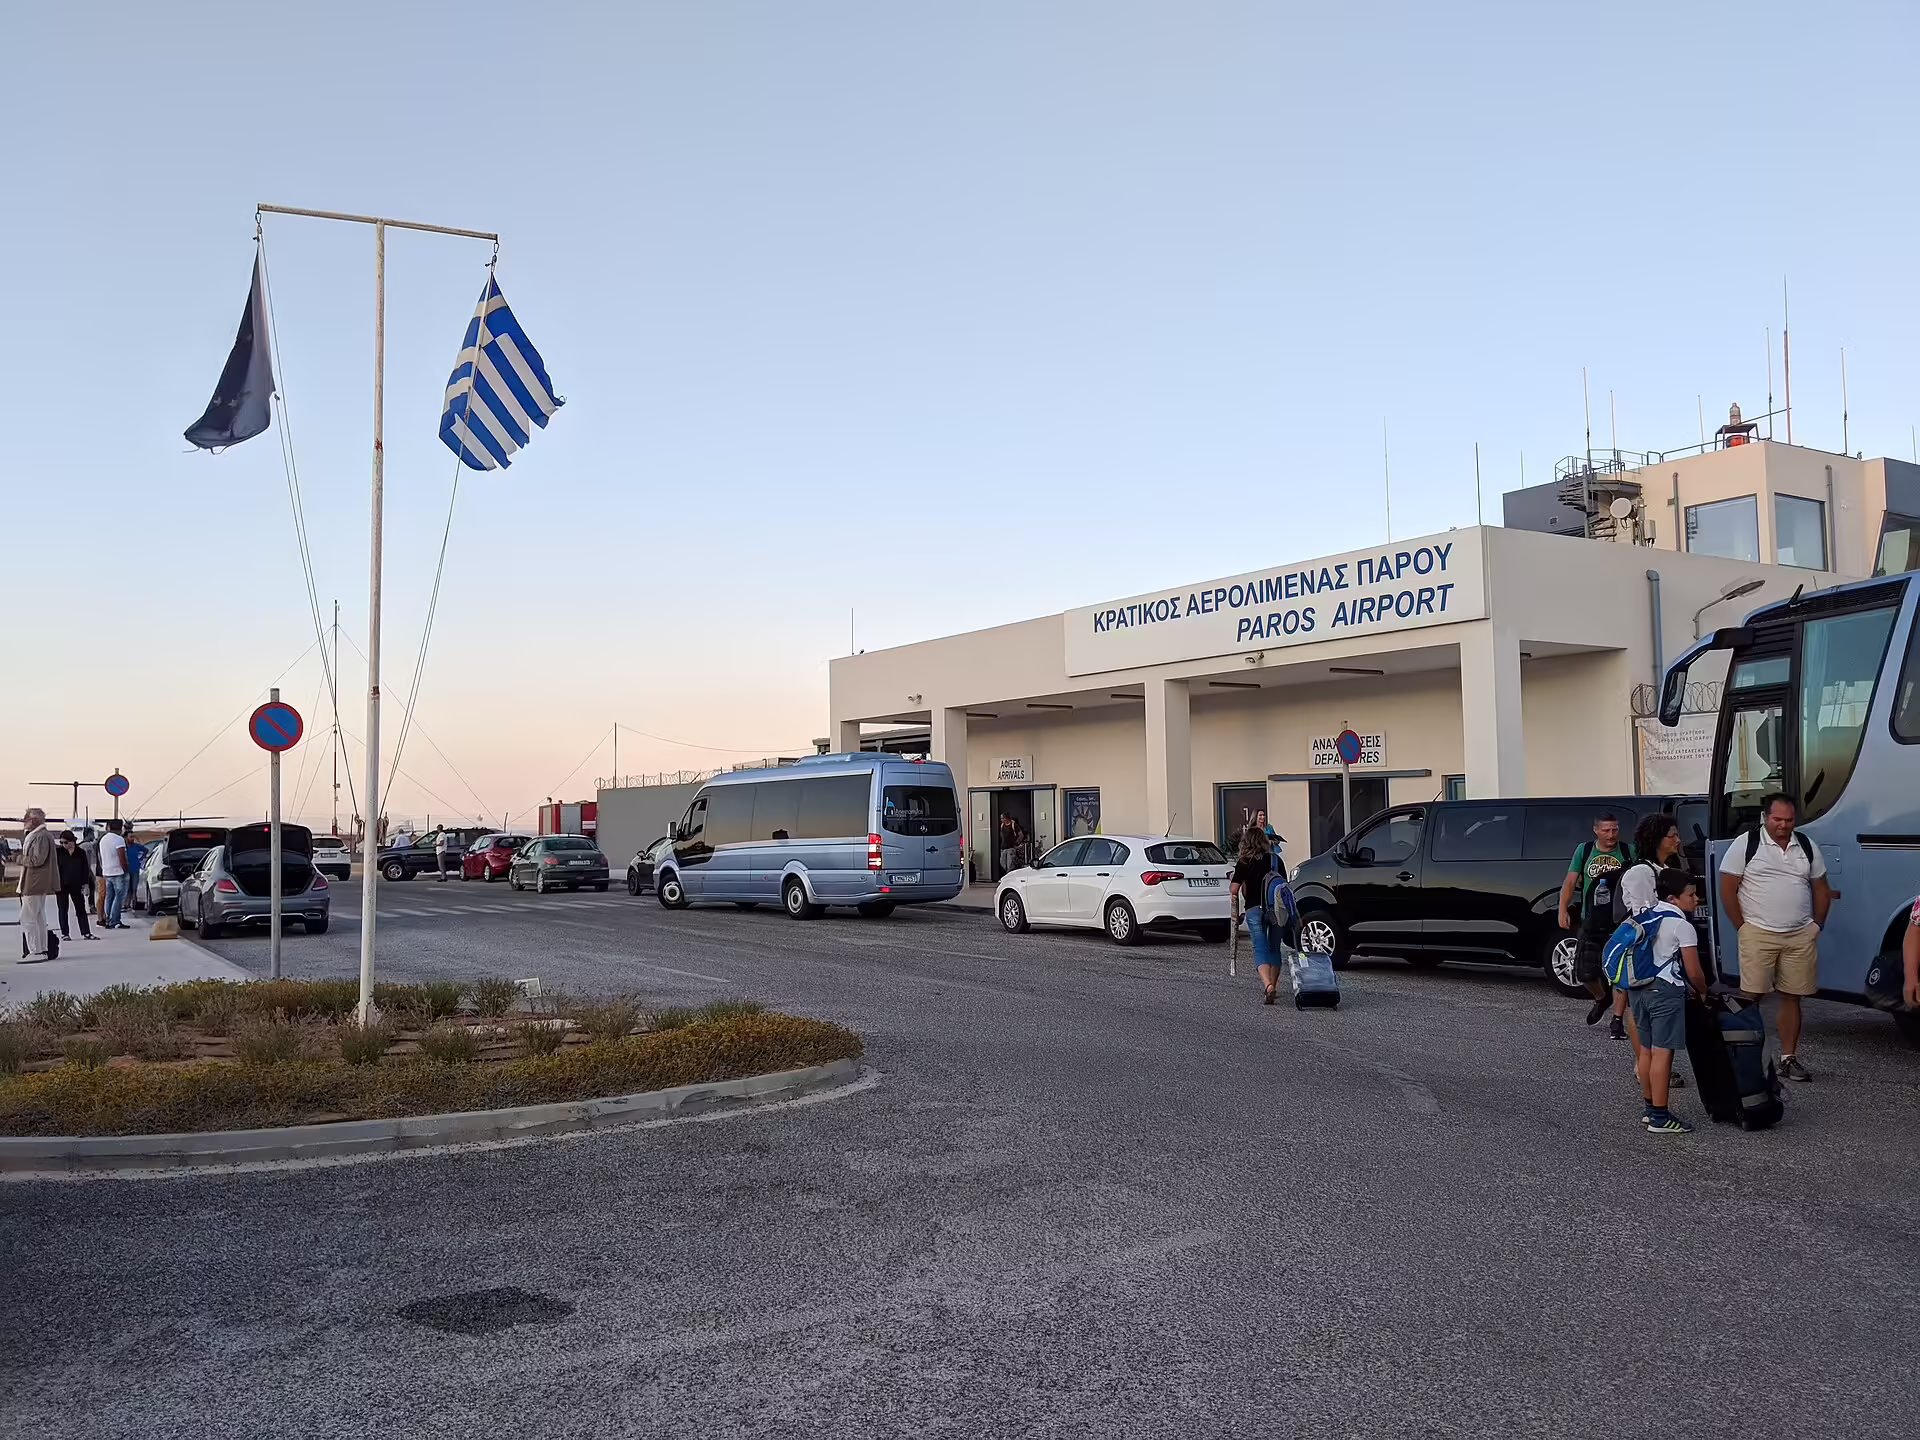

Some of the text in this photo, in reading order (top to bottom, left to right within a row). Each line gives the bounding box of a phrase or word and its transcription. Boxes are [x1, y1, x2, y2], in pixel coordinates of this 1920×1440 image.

[1093, 543, 1453, 633] ΚΡΑΤΙΚΟΣ ΑΕΡΟΛΙΜΕΝΑΣ ΠΑΡΟΥ
[1236, 583, 1454, 643] PAROS AIRPORT
[1312, 735, 1382, 751] ΑΝΑΧΣΕΙΣ
[1314, 751, 1380, 765] DEPARES
[997, 770, 1025, 780] ARRIVALS
